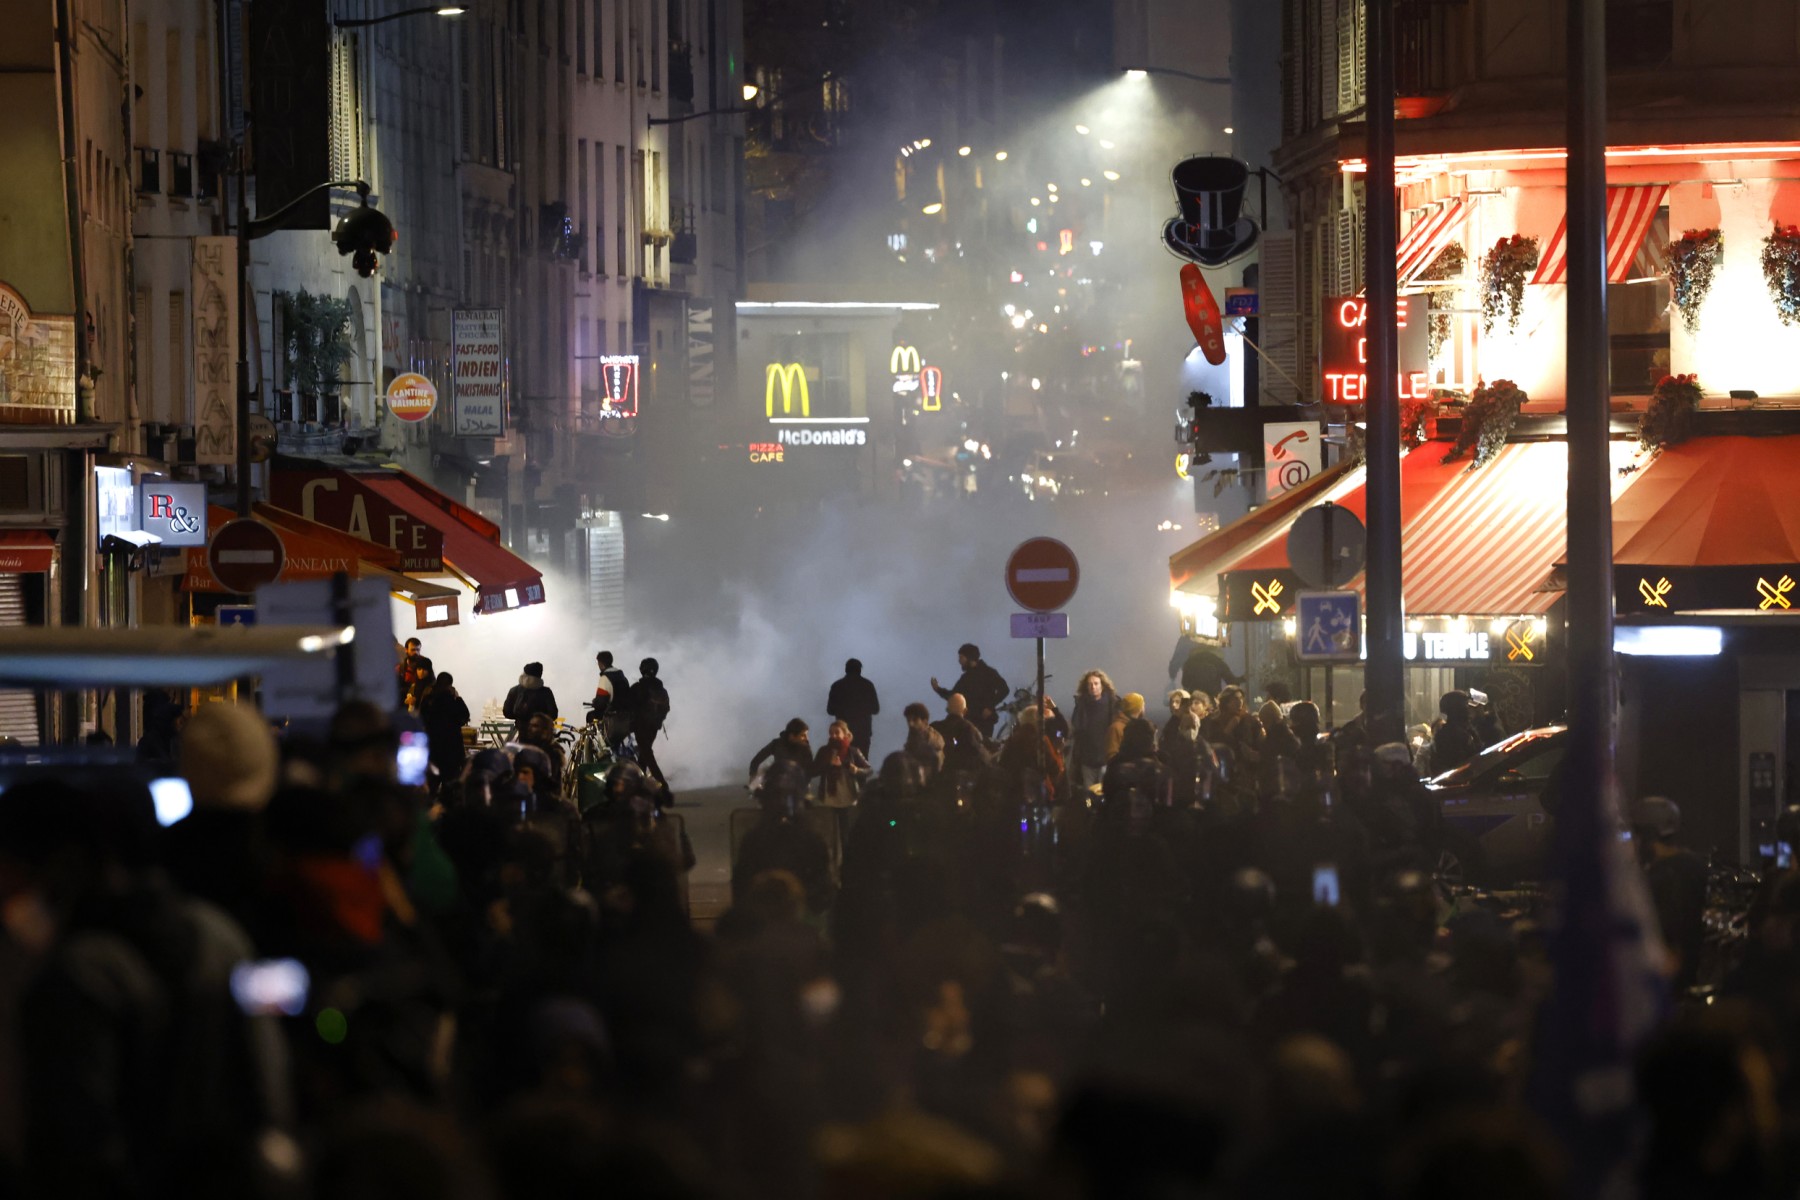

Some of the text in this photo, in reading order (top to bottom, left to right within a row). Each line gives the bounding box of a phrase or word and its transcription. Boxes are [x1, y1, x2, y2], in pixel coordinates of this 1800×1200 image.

[1232, 296, 1253, 306] FDJ
[1188, 279, 1218, 350] TABAC
[1340, 300, 1408, 328] CAE
[478, 323, 499, 331] FIED
[197, 243, 233, 456] HAMMAM
[456, 343, 499, 356] FAST-FOOD
[457, 361, 498, 377] INDIEN
[393, 388, 429, 398] CANTINE
[456, 383, 500, 397] PAKISTANAIS
[1325, 372, 1428, 401] TELE
[391, 398, 432, 408] BALINAISE
[464, 405, 493, 415] HALAL
[460, 418, 498, 432] حلال
[749, 443, 784, 452] PIZZA
[750, 452, 784, 462] CAFE
[1422, 632, 1489, 659] TEMPLE
